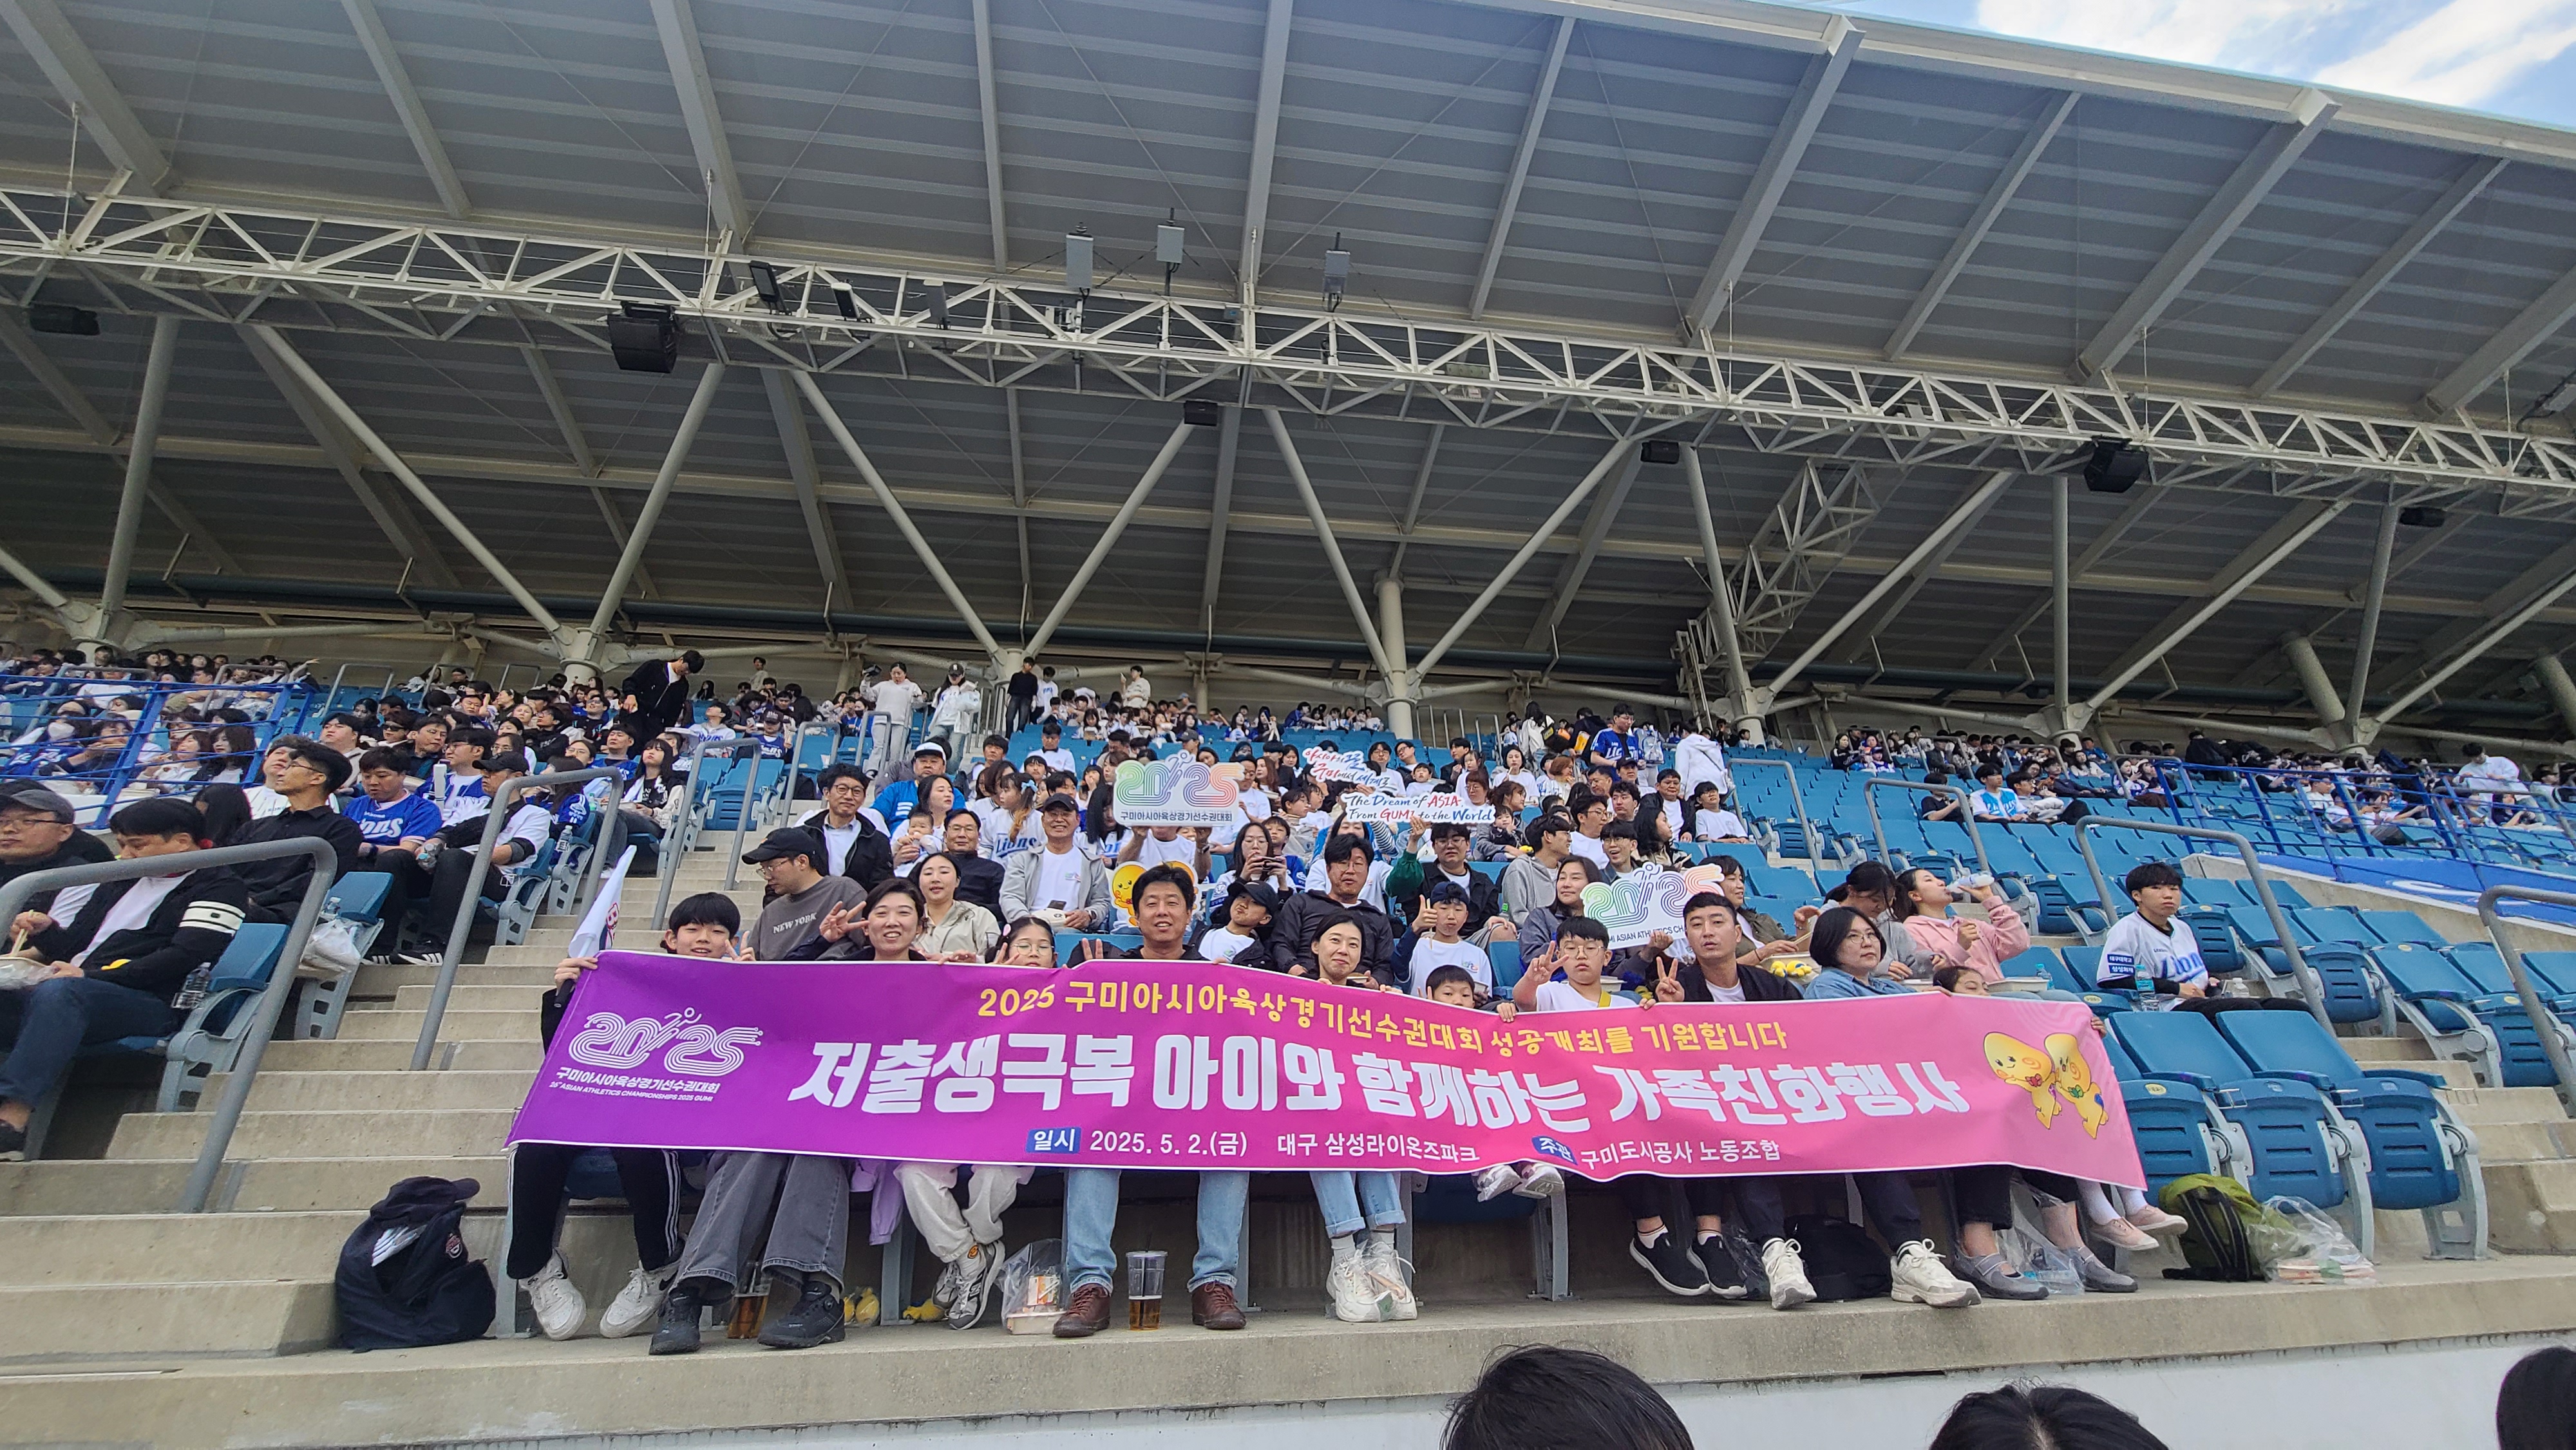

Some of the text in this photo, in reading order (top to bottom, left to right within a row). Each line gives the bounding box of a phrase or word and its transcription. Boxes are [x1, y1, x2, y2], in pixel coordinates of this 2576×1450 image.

[1345, 795, 1370, 806] The
[1372, 795, 1410, 806] Dream
[1413, 795, 1428, 809] of
[1120, 811, 1233, 822] 구미아시아육상경기선수권대회
[1349, 808, 1377, 820] From
[1417, 811, 1430, 820] to
[1432, 810, 1451, 820] the
[1452, 809, 1493, 821] World
[773, 912, 817, 934] NEW YORK
[1616, 932, 1636, 942] ASIAN
[978, 981, 1787, 1057] 2025 구미아시아육상경기선수권대회 성공개최를 기원합니다
[556, 1066, 721, 1094] 구미아시아육상경기선수권대회
[559, 1083, 583, 1092] ASIAN
[582, 1086, 622, 1097] ATHLETICS
[621, 1090, 678, 1100] CHAMPIONSHIPS
[788, 1033, 1971, 1133] 저출생극복 아이와 함께하는 가족친화행사
[1034, 1129, 1075, 1152] 일시
[1090, 1131, 1152, 1154] 2025.
[1160, 1132, 1180, 1154] 5.
[1277, 1131, 1481, 1163] 대구 삼성라이온즈파크
[1539, 1137, 1781, 1171] 주관 구미도시공사 노동조합
